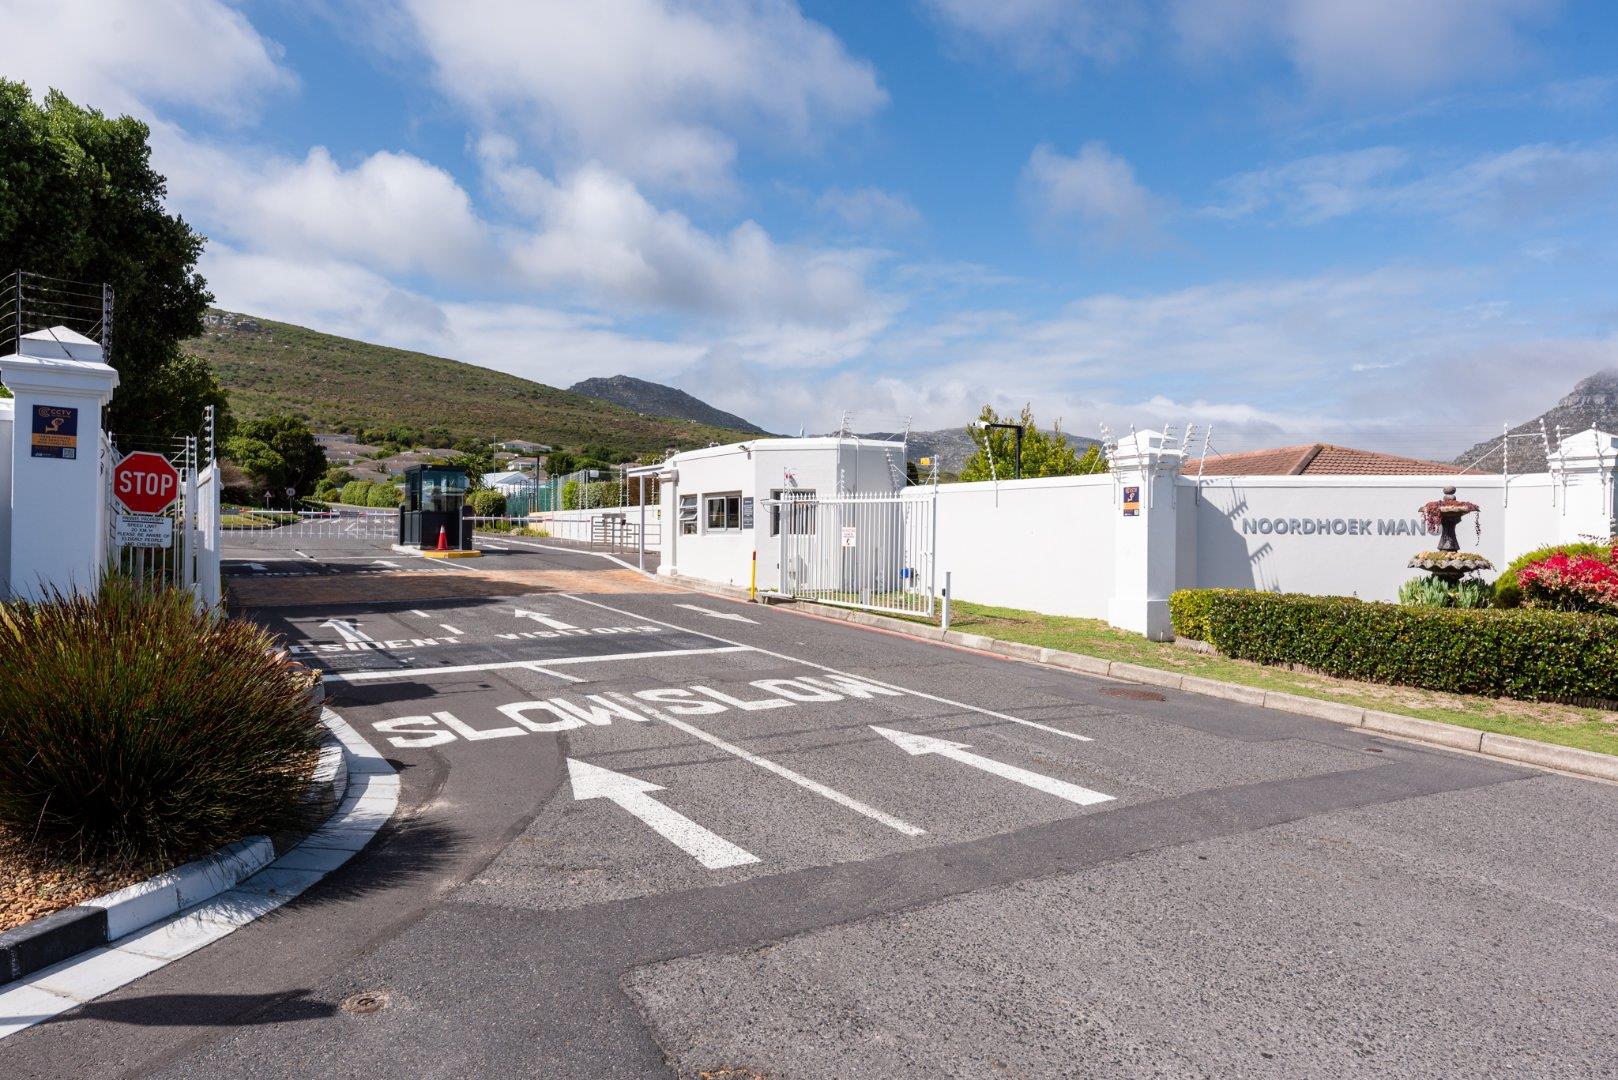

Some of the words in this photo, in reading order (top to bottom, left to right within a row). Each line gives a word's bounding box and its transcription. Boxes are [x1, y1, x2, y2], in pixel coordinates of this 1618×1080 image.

[50, 408, 72, 416] CCTV
[119, 470, 174, 497] STOP
[1242, 517, 1373, 535] NOORDHOEK
[494, 625, 662, 640] VISITORS
[285, 637, 460, 654] ESIDENT
[633, 674, 903, 715] SLOW
[371, 694, 650, 749] SLOW
